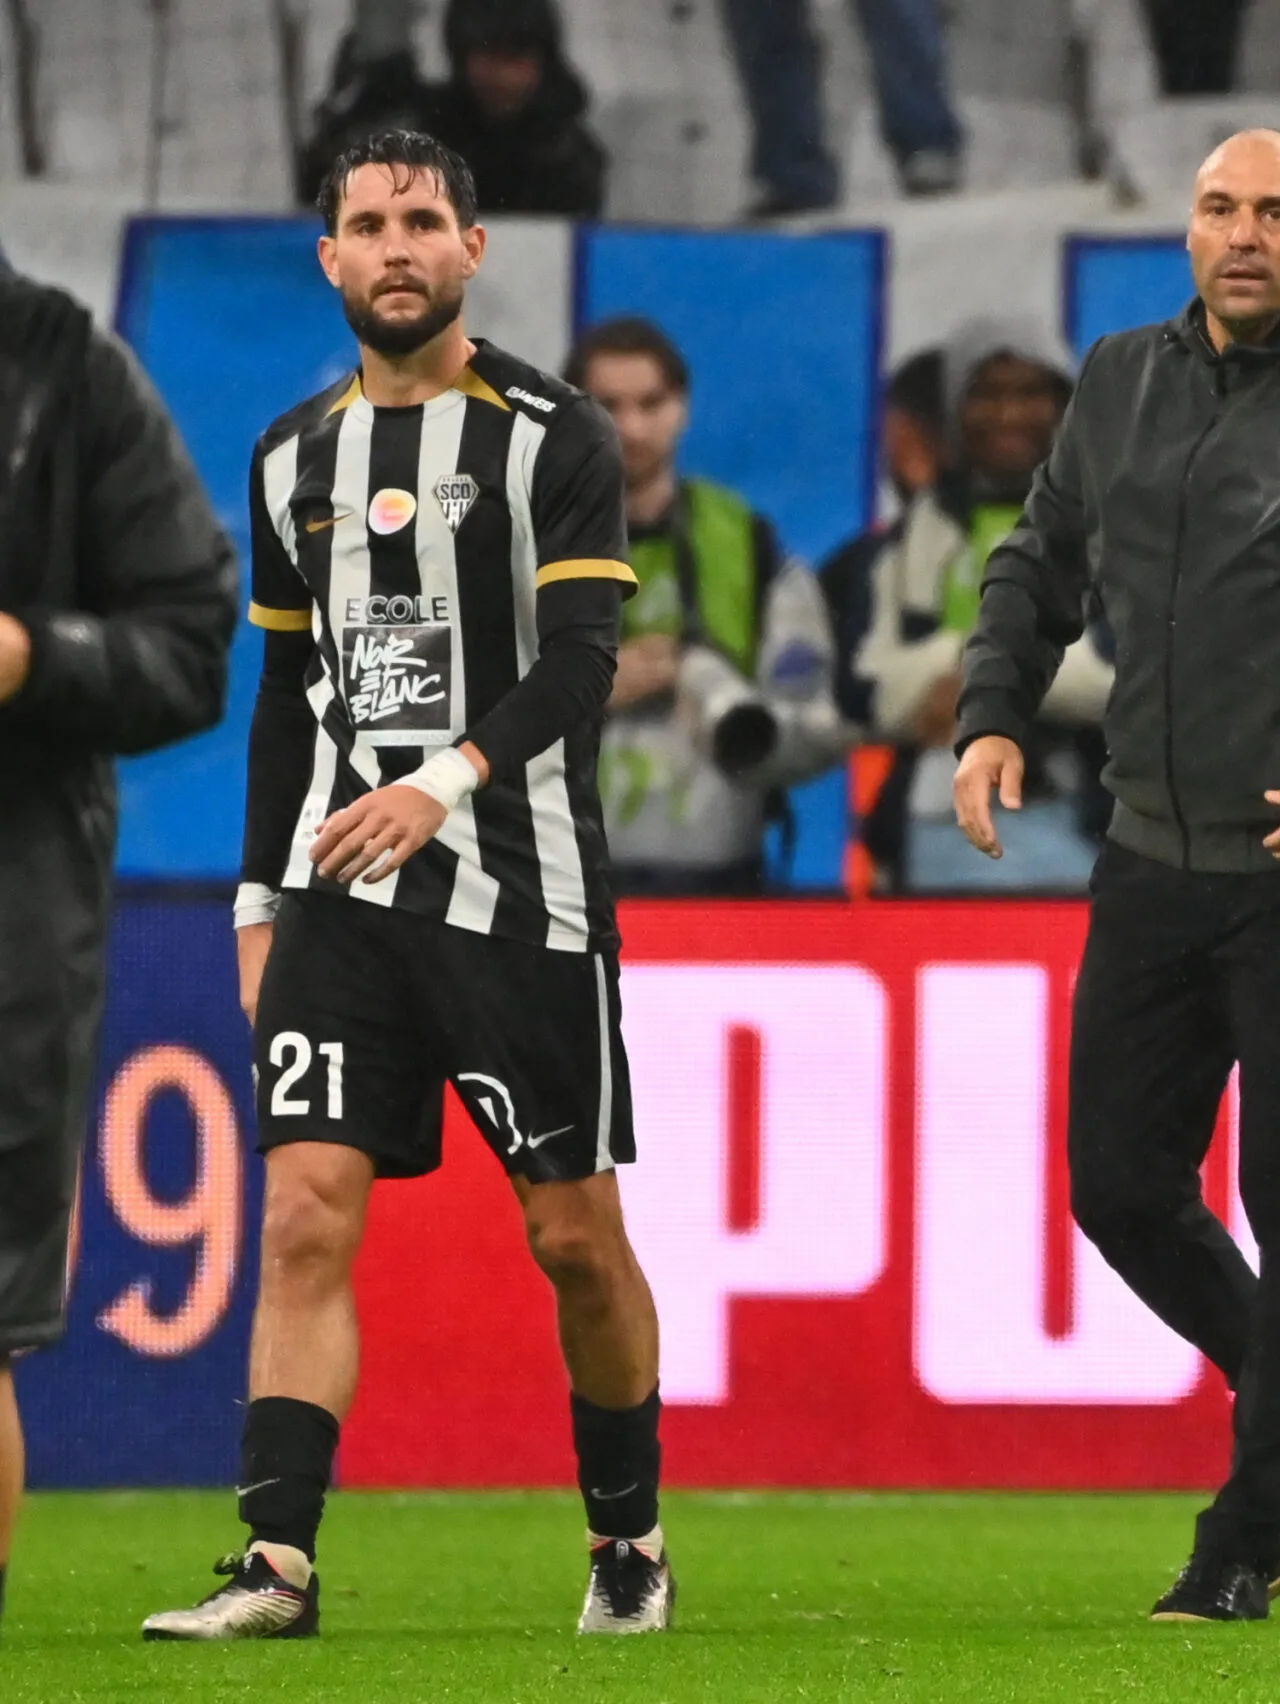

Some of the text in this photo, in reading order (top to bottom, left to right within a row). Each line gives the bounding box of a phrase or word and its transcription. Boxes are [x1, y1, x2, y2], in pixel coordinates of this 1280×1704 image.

[439, 482, 471, 501] SCO
[349, 673, 447, 724] BLANC
[268, 1030, 344, 1120] 21
